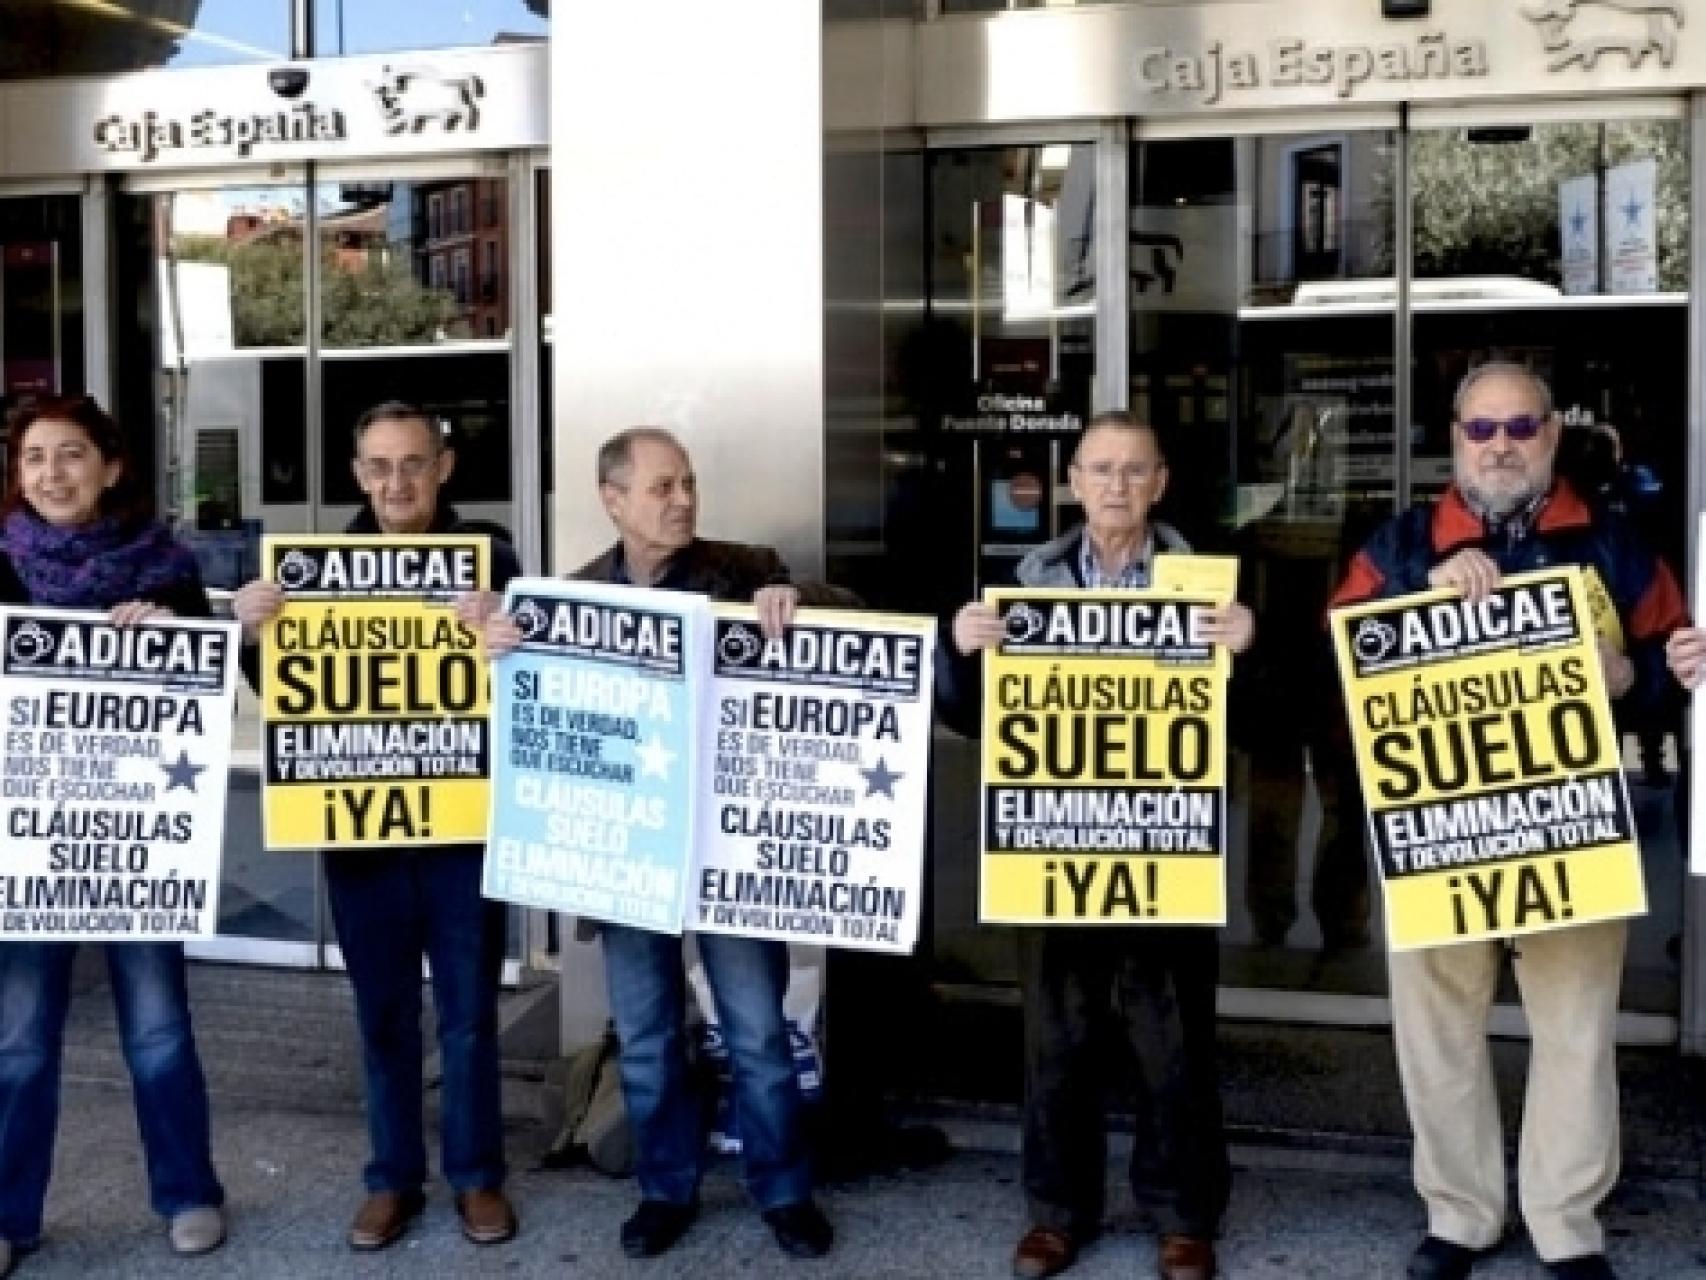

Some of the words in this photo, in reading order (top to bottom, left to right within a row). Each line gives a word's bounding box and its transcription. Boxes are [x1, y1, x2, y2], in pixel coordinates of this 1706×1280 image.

[1141, 39, 1259, 105] Caja
[1268, 31, 1489, 99] España
[93, 107, 184, 163] Caja
[190, 100, 349, 158] España
[320, 549, 478, 589] ADICAE
[275, 607, 478, 652] CLÁUSULAS
[550, 601, 681, 658] ADICAE
[1045, 601, 1210, 646] ADICAE
[1401, 582, 1574, 655] ADICAE
[57, 624, 224, 673] ADICAE
[760, 630, 919, 682] ADICAE
[275, 654, 479, 715] SUELO
[512, 670, 541, 701] SI
[543, 665, 672, 723] EUROPA
[997, 664, 1213, 712] CLÁUSULAS
[1363, 657, 1588, 733] CLÁUSULAS
[10, 696, 40, 728] SI
[46, 690, 205, 736] EUROPA
[276, 714, 481, 755] ELIMINACIÓN
[511, 703, 535, 723] ES
[540, 706, 561, 727] DE
[719, 698, 748, 729] SI
[752, 692, 902, 743] EUROPA
[6, 732, 34, 755] ES
[39, 732, 67, 755] DE
[511, 727, 549, 751] NOS
[716, 731, 744, 752] ES
[746, 733, 772, 755] DE
[997, 713, 1212, 781] SUELO
[1371, 700, 1602, 800] SUELO
[3, 778, 43, 799] QUE
[46, 780, 156, 804] ESCUCHAR
[4, 757, 51, 777] NOS
[277, 758, 293, 780] Y
[421, 755, 478, 777] TOTAL
[8, 801, 194, 843] CLÁUSULAS
[323, 785, 432, 842] ¡YA!
[720, 800, 892, 851] CLÁUSULAS
[998, 786, 1213, 828] ELIMINACIÓN
[1385, 774, 1617, 849] ELIMINACIÓN
[47, 842, 149, 874] SUELO
[546, 813, 629, 855] SUELO
[997, 828, 1012, 848] Y
[1146, 828, 1213, 852] TOTAL
[1391, 850, 1408, 873] Y
[1550, 817, 1624, 851] TOTAL
[756, 840, 850, 878] SUELO
[699, 867, 906, 921] ELIMINACIÓN
[1043, 860, 1160, 918] ¡YA!
[1446, 859, 1575, 935] ¡YA!
[139, 912, 202, 934] TOTAL
